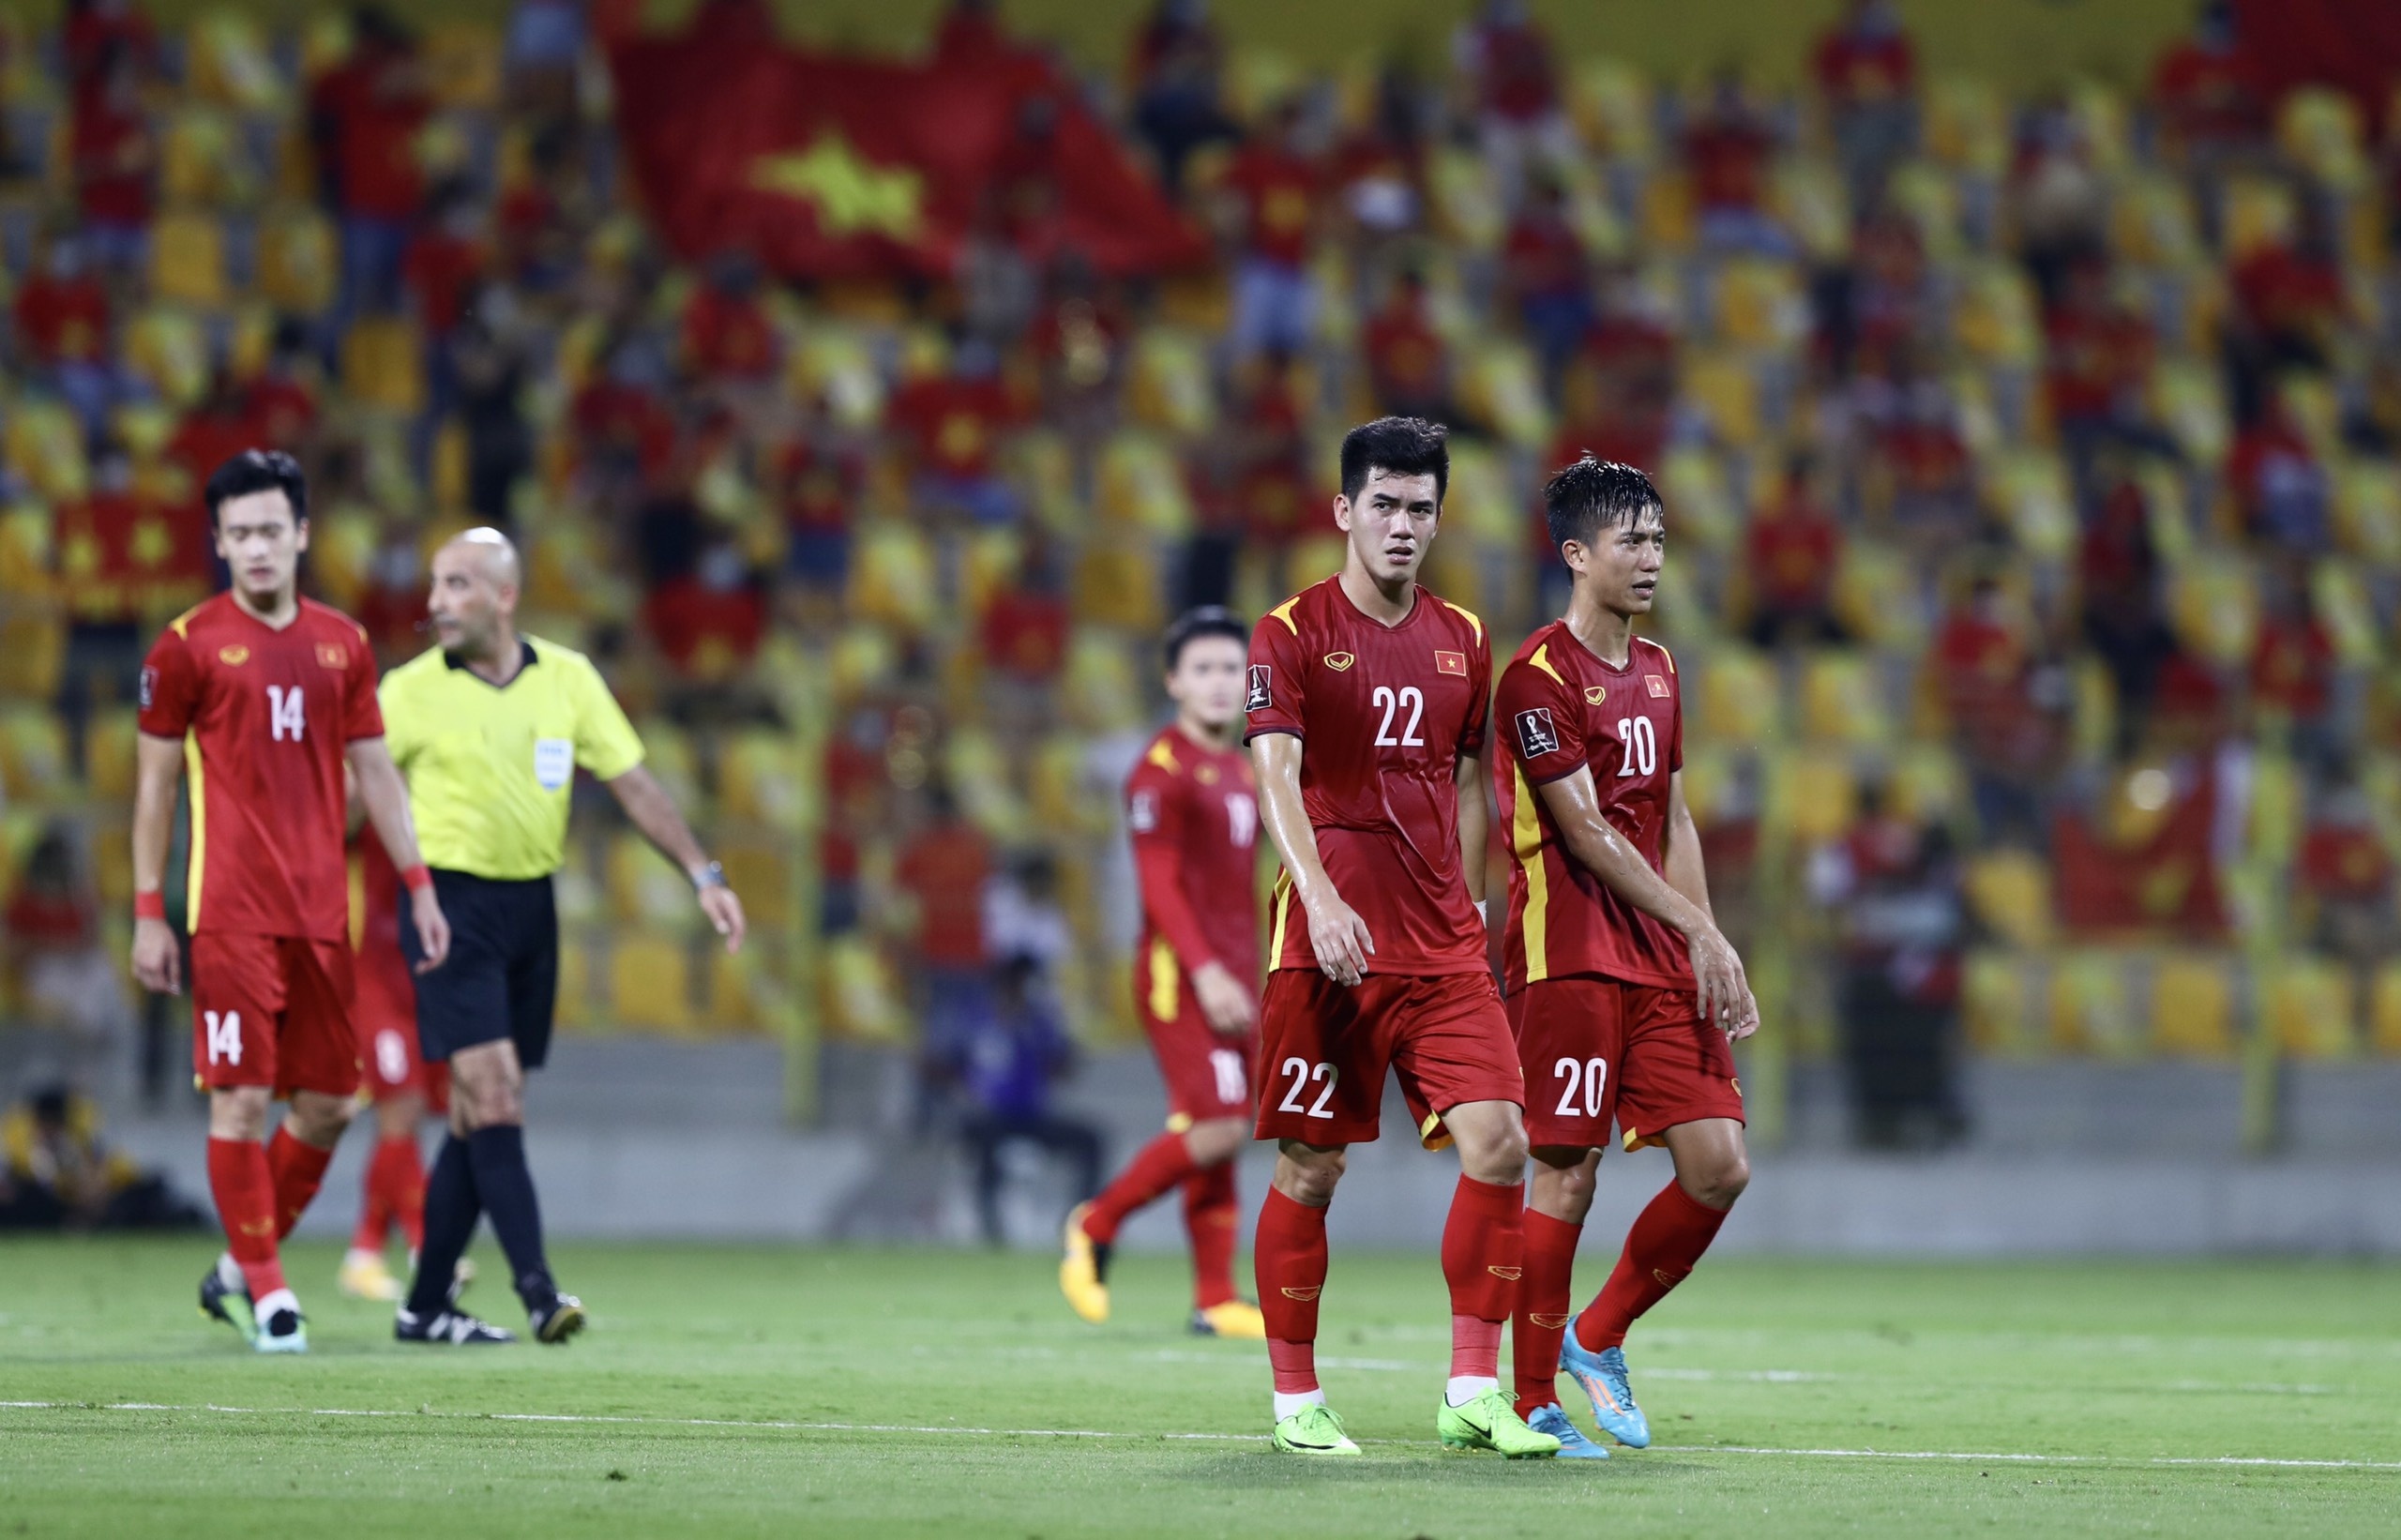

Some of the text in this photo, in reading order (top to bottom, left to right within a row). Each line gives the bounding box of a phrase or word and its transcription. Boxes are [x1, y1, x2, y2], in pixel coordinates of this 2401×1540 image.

[266, 684, 305, 742] 14
[1372, 686, 1424, 747] 22
[1617, 715, 1656, 778] 20
[204, 1009, 243, 1066] 14
[1277, 1057, 1338, 1119] 22
[1554, 1056, 1608, 1117] 20
